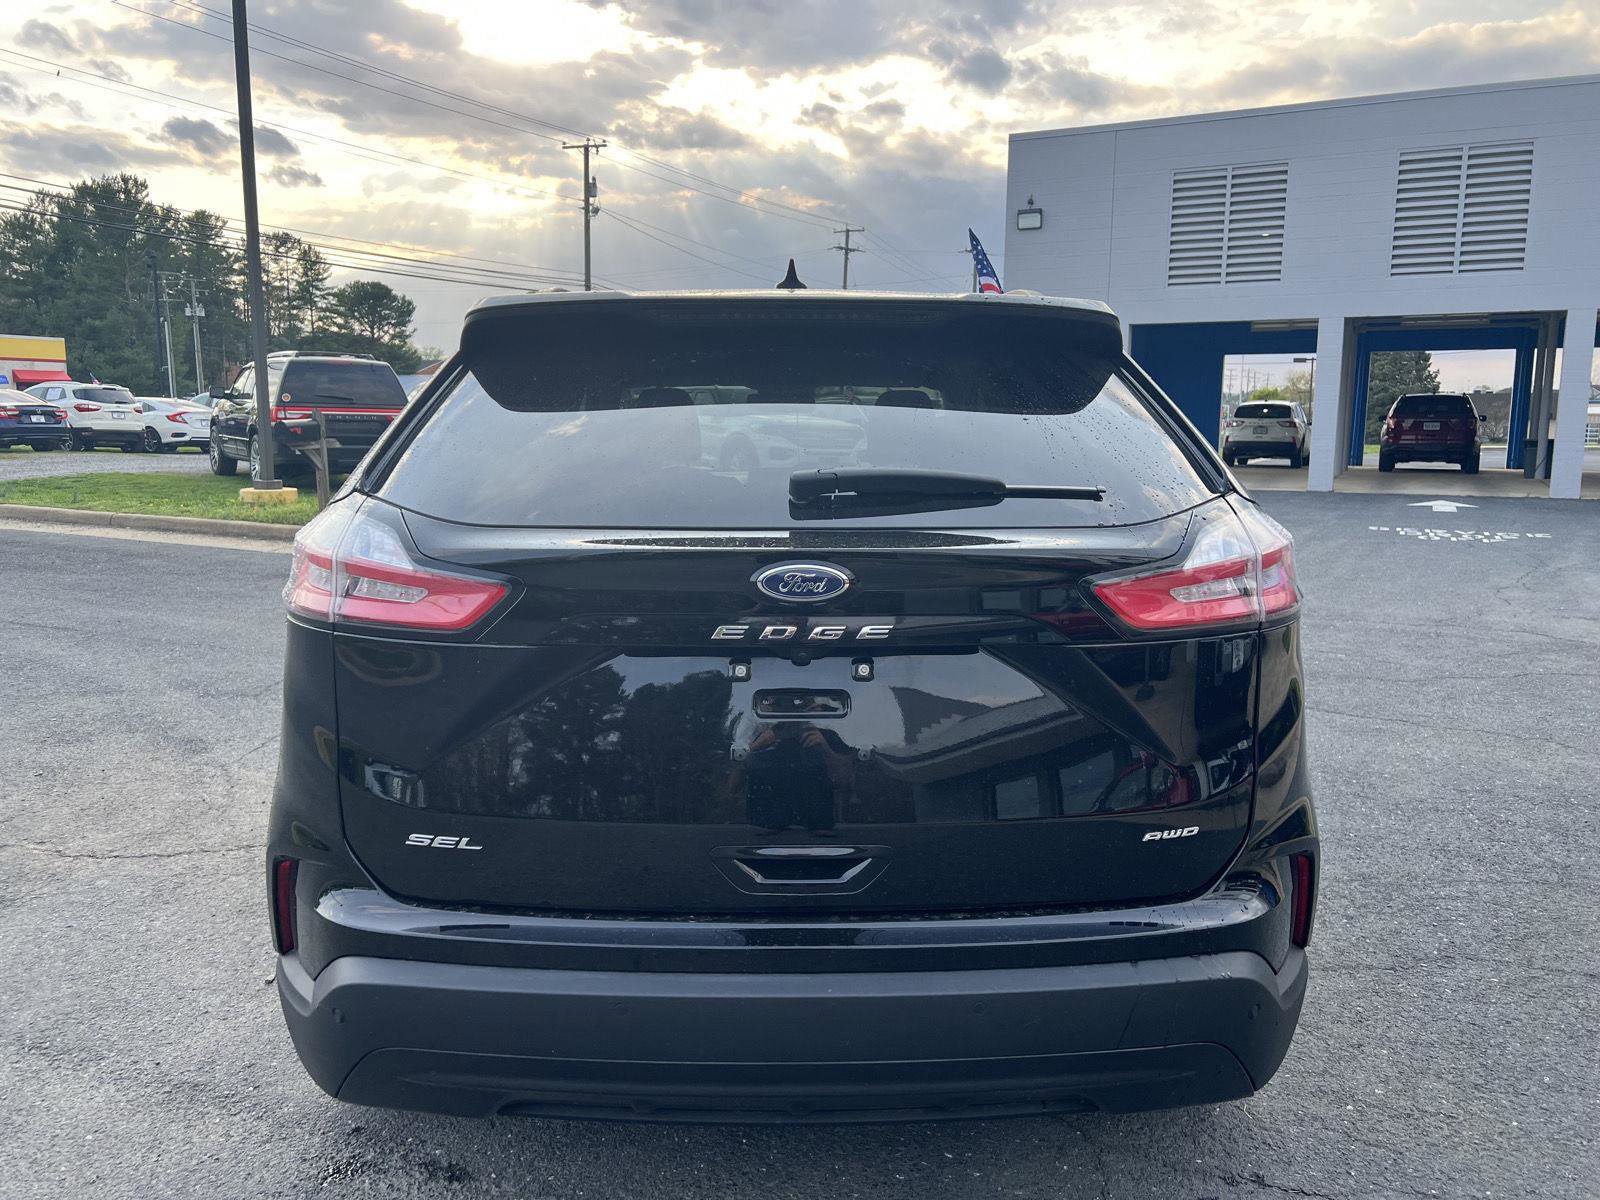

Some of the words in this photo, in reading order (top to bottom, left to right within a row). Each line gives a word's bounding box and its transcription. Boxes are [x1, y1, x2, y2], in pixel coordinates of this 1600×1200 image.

[779, 572, 827, 593] Ford
[710, 625, 894, 640] EDGE
[405, 833, 483, 850] SEL
[1142, 826, 1200, 842] AWD
